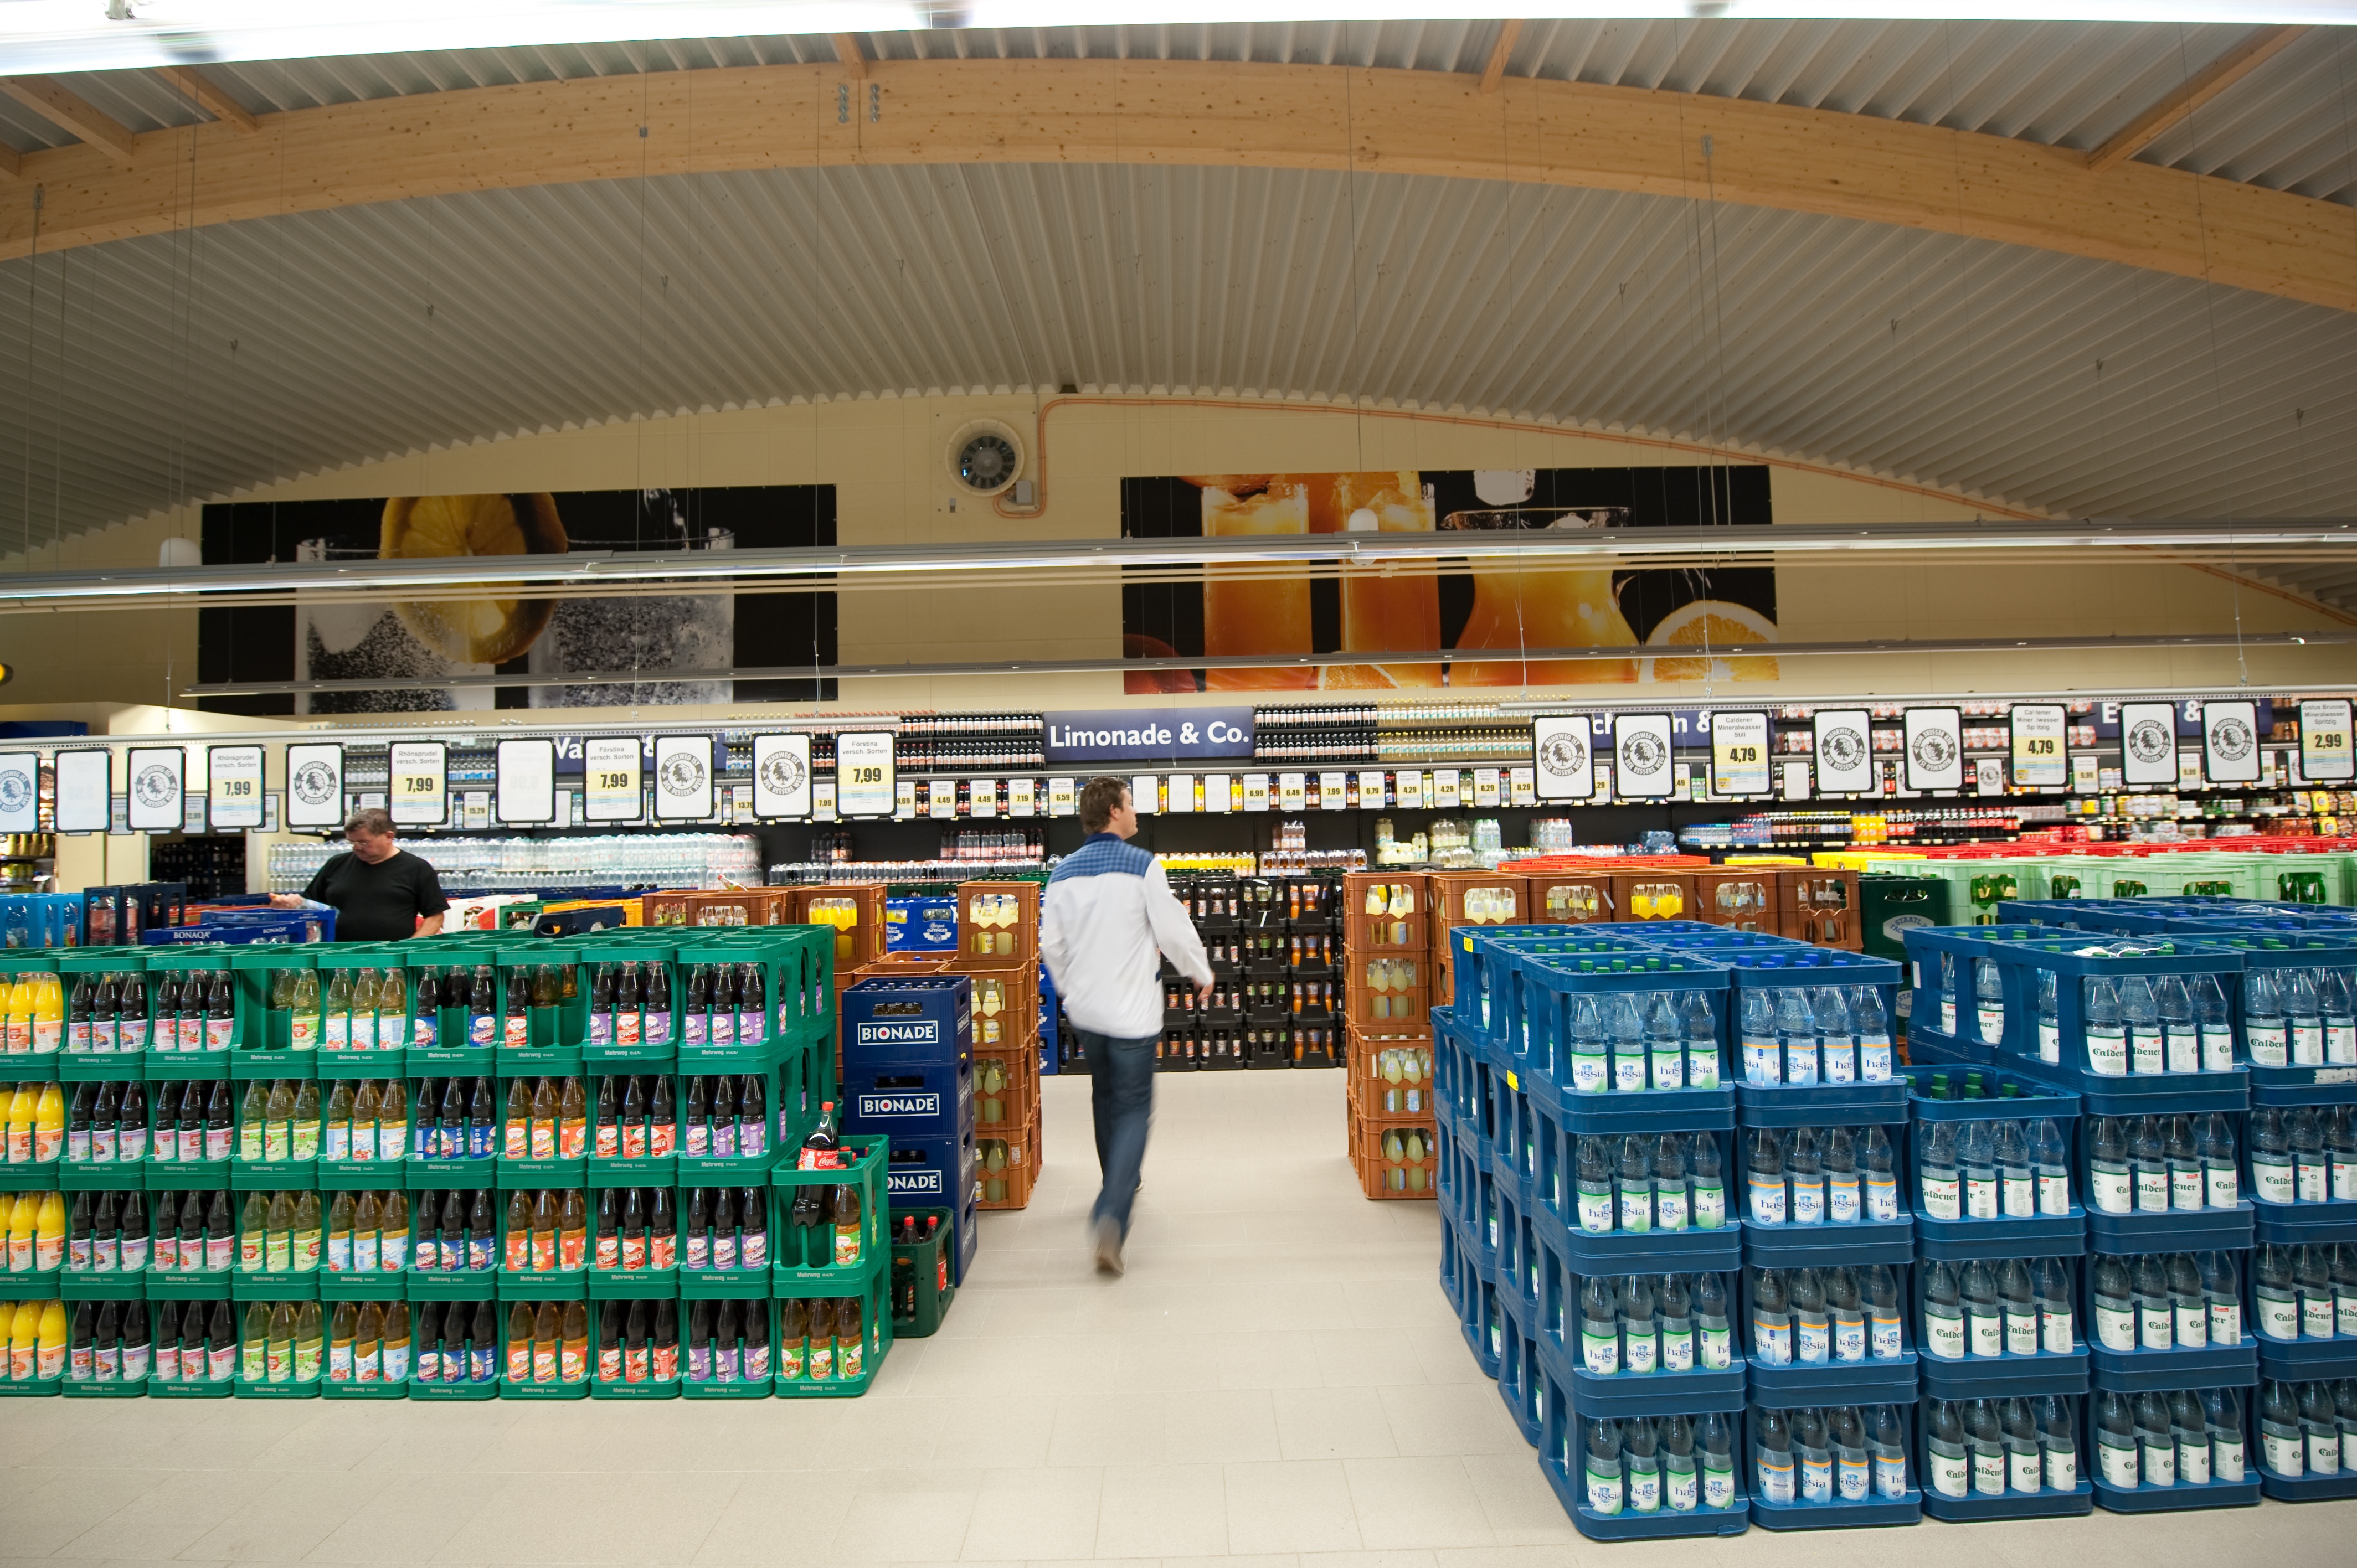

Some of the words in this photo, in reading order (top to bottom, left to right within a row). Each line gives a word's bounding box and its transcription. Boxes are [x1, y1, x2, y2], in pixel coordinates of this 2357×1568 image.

[1050, 723, 1172, 747] Limonade
[1179, 722, 1200, 744] &
[1207, 721, 1249, 744] Co.
[1545, 733, 1571, 746] MEHRWEG
[1627, 732, 1653, 745] MEHRWEG
[1826, 728, 1851, 741] MEHRWEG
[2315, 734, 2341, 749] 2,99
[1730, 747, 1756, 763] 4,79
[2027, 740, 2054, 755] 4,79
[665, 754, 690, 766] MEHRWEG
[765, 752, 790, 765] MEHRWEG
[1824, 754, 1833, 765] DER
[1833, 762, 1855, 770] BESSERE
[1543, 760, 1552, 770] DER
[1552, 767, 1574, 776] BESSERE
[1625, 759, 1634, 769] DER
[1634, 766, 1656, 775] BESSERE
[600, 773, 628, 789] 7,99
[853, 768, 881, 782] 7,99
[224, 781, 251, 796] 7,99
[406, 778, 433, 793] 7,99
[662, 780, 672, 791] DER
[672, 787, 694, 796] BESSERE
[763, 778, 771, 789] DER
[772, 786, 794, 795] BESSERE
[862, 1025, 934, 1041] BIONADE
[863, 1099, 935, 1113] BIONADE
